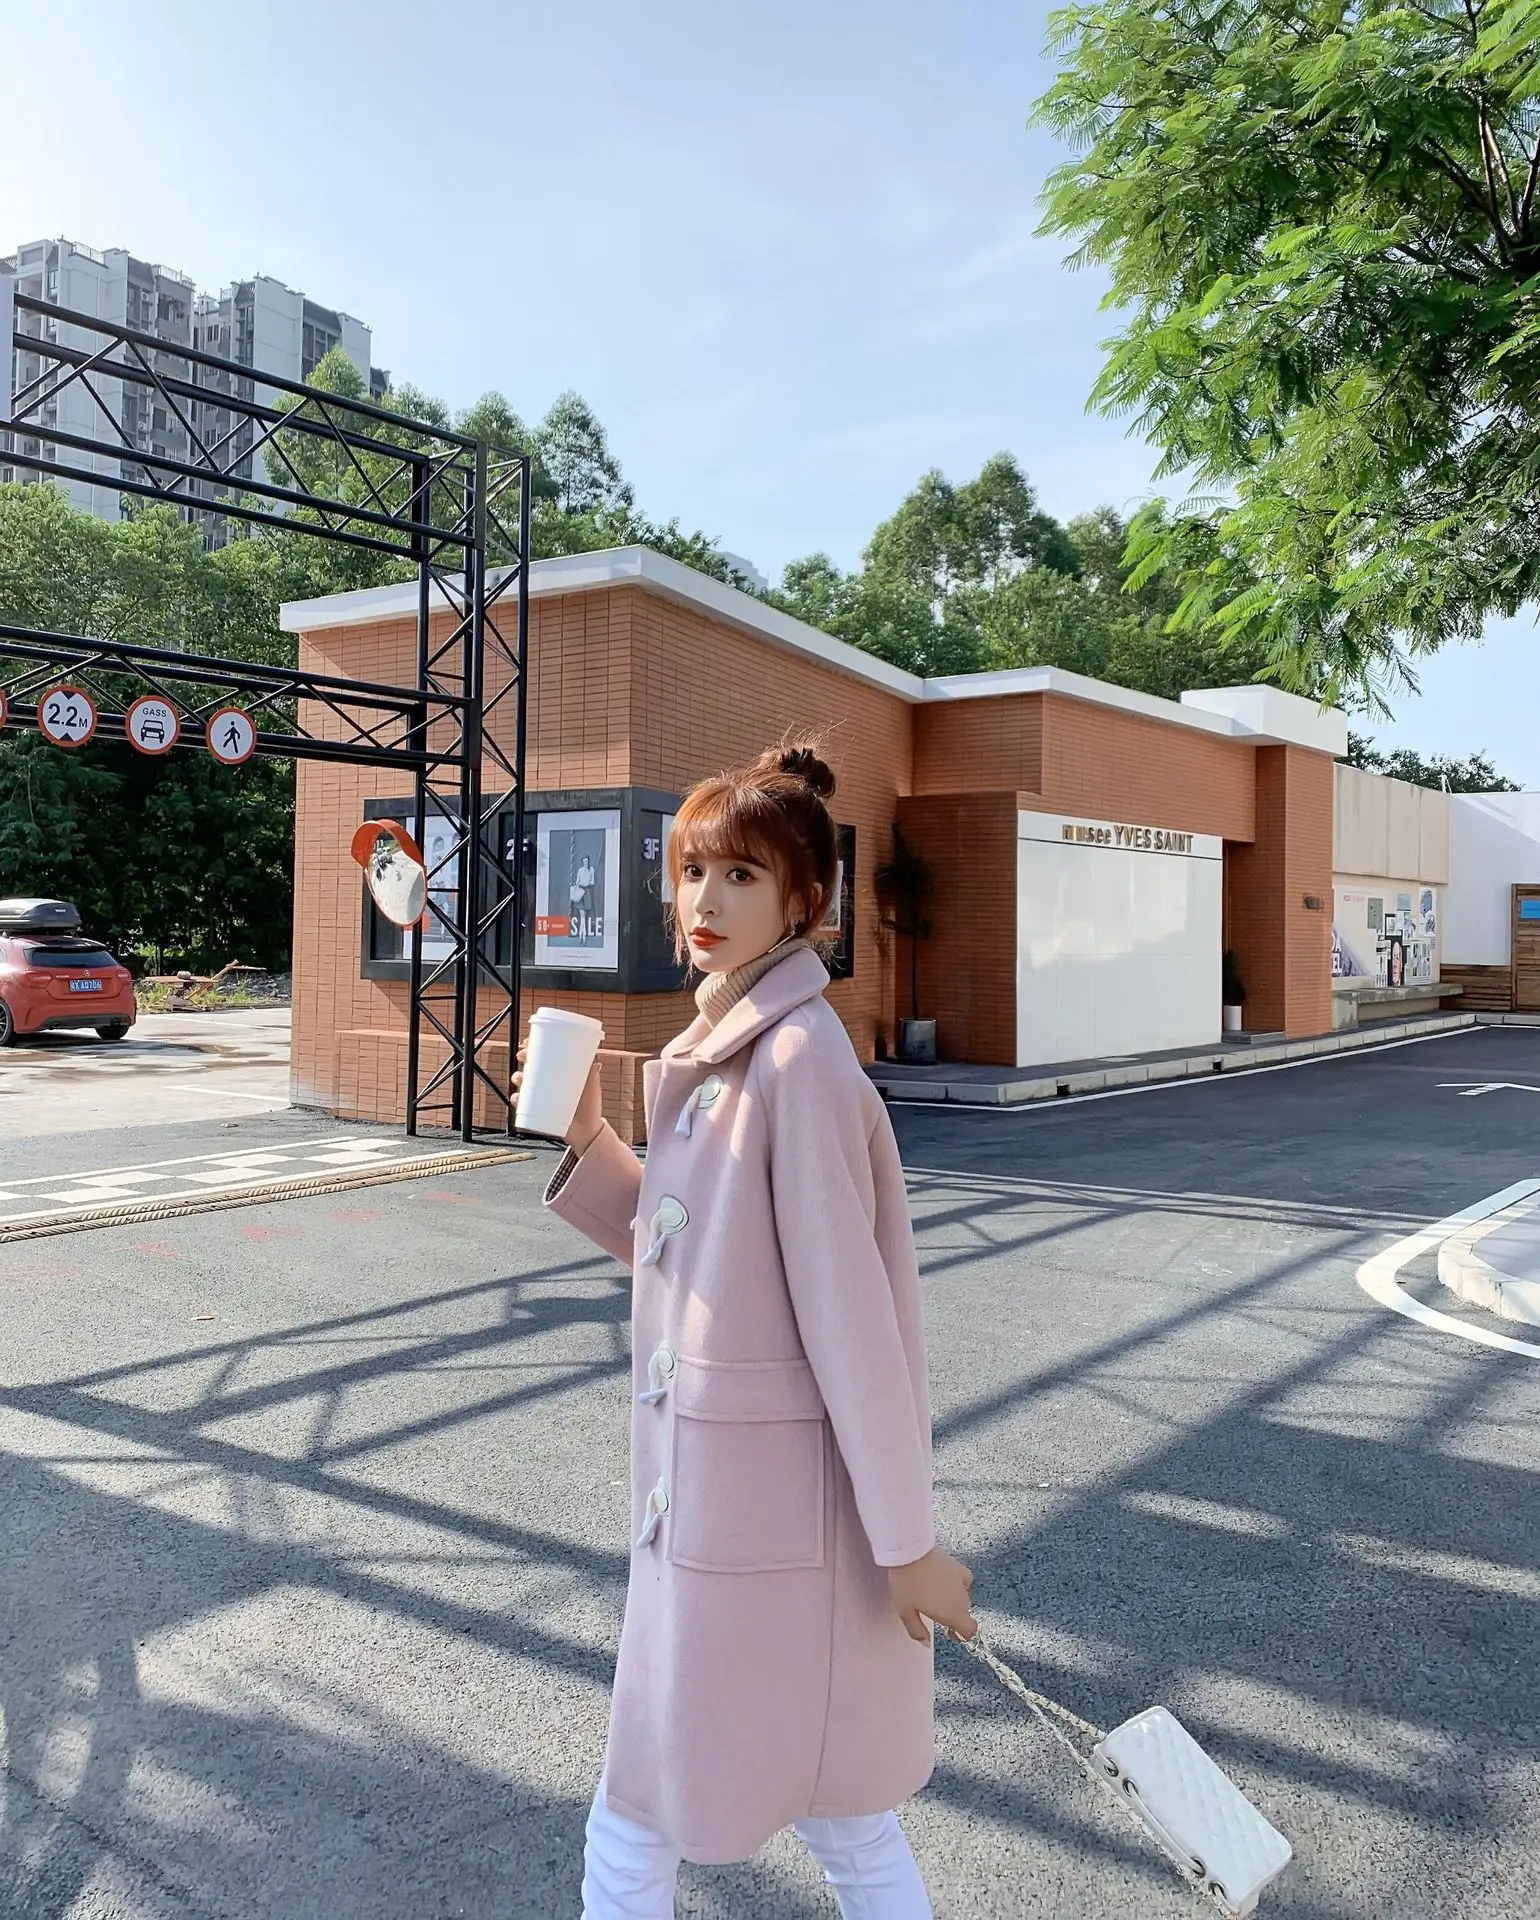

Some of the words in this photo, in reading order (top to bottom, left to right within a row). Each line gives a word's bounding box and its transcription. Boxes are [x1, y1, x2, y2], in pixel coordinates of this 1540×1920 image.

[142, 707, 167, 718] GASS
[643, 838, 660, 860] 3F
[1113, 824, 1152, 849] YVES
[1153, 830, 1194, 853] SAINT
[570, 916, 603, 937] SALE
